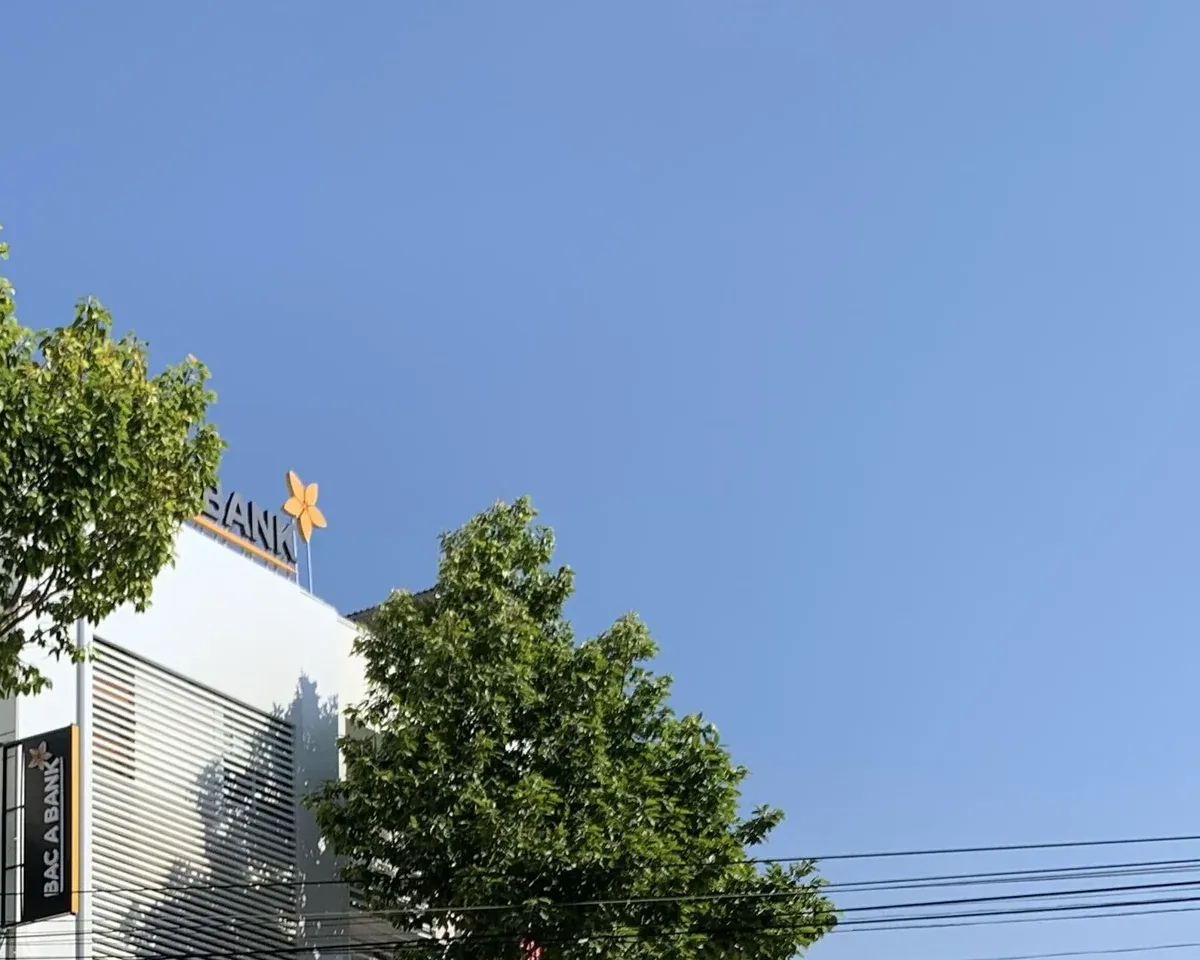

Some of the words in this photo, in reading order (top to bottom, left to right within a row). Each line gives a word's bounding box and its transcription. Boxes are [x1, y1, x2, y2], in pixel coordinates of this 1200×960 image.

[43, 754, 60, 823] BANK
[43, 825, 60, 843] A
[43, 848, 60, 897] BAC
